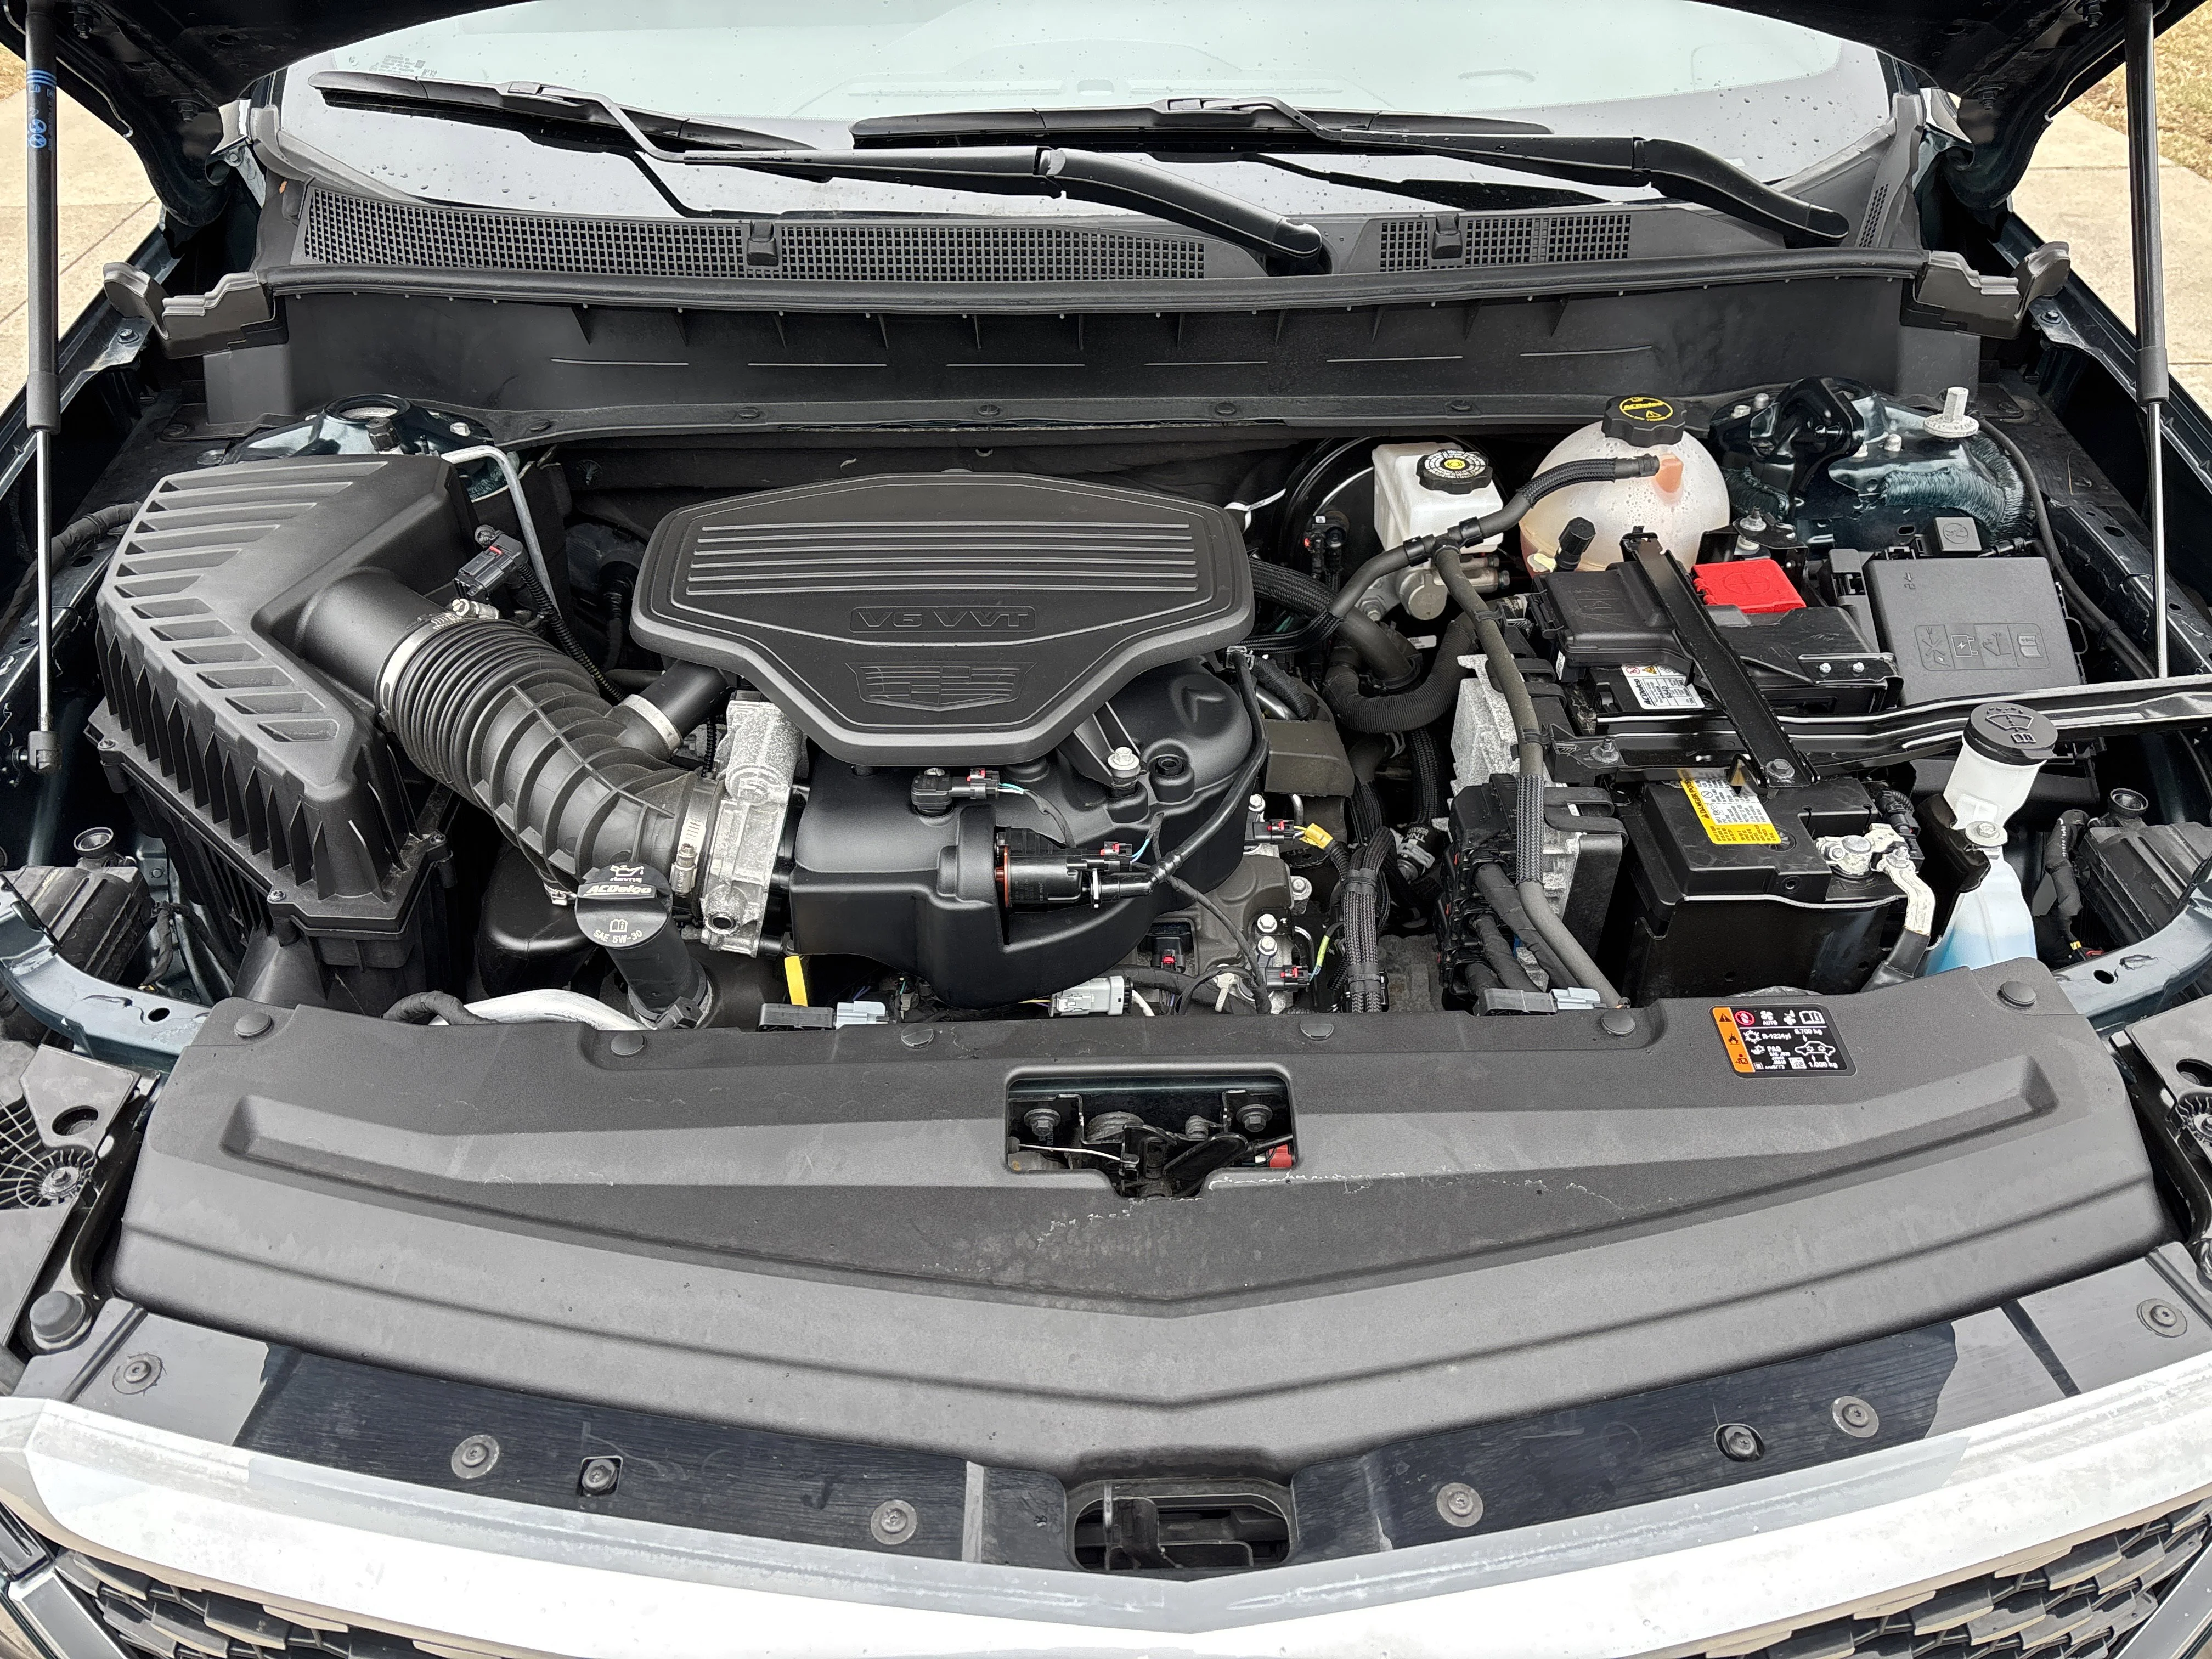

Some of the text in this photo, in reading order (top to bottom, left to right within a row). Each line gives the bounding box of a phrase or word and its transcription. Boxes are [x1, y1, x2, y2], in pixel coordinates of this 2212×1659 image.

[858, 611, 1029, 628] V6 VVT
[586, 884, 652, 894] ACDelco
[593, 929, 643, 944] SAE 5W-30
